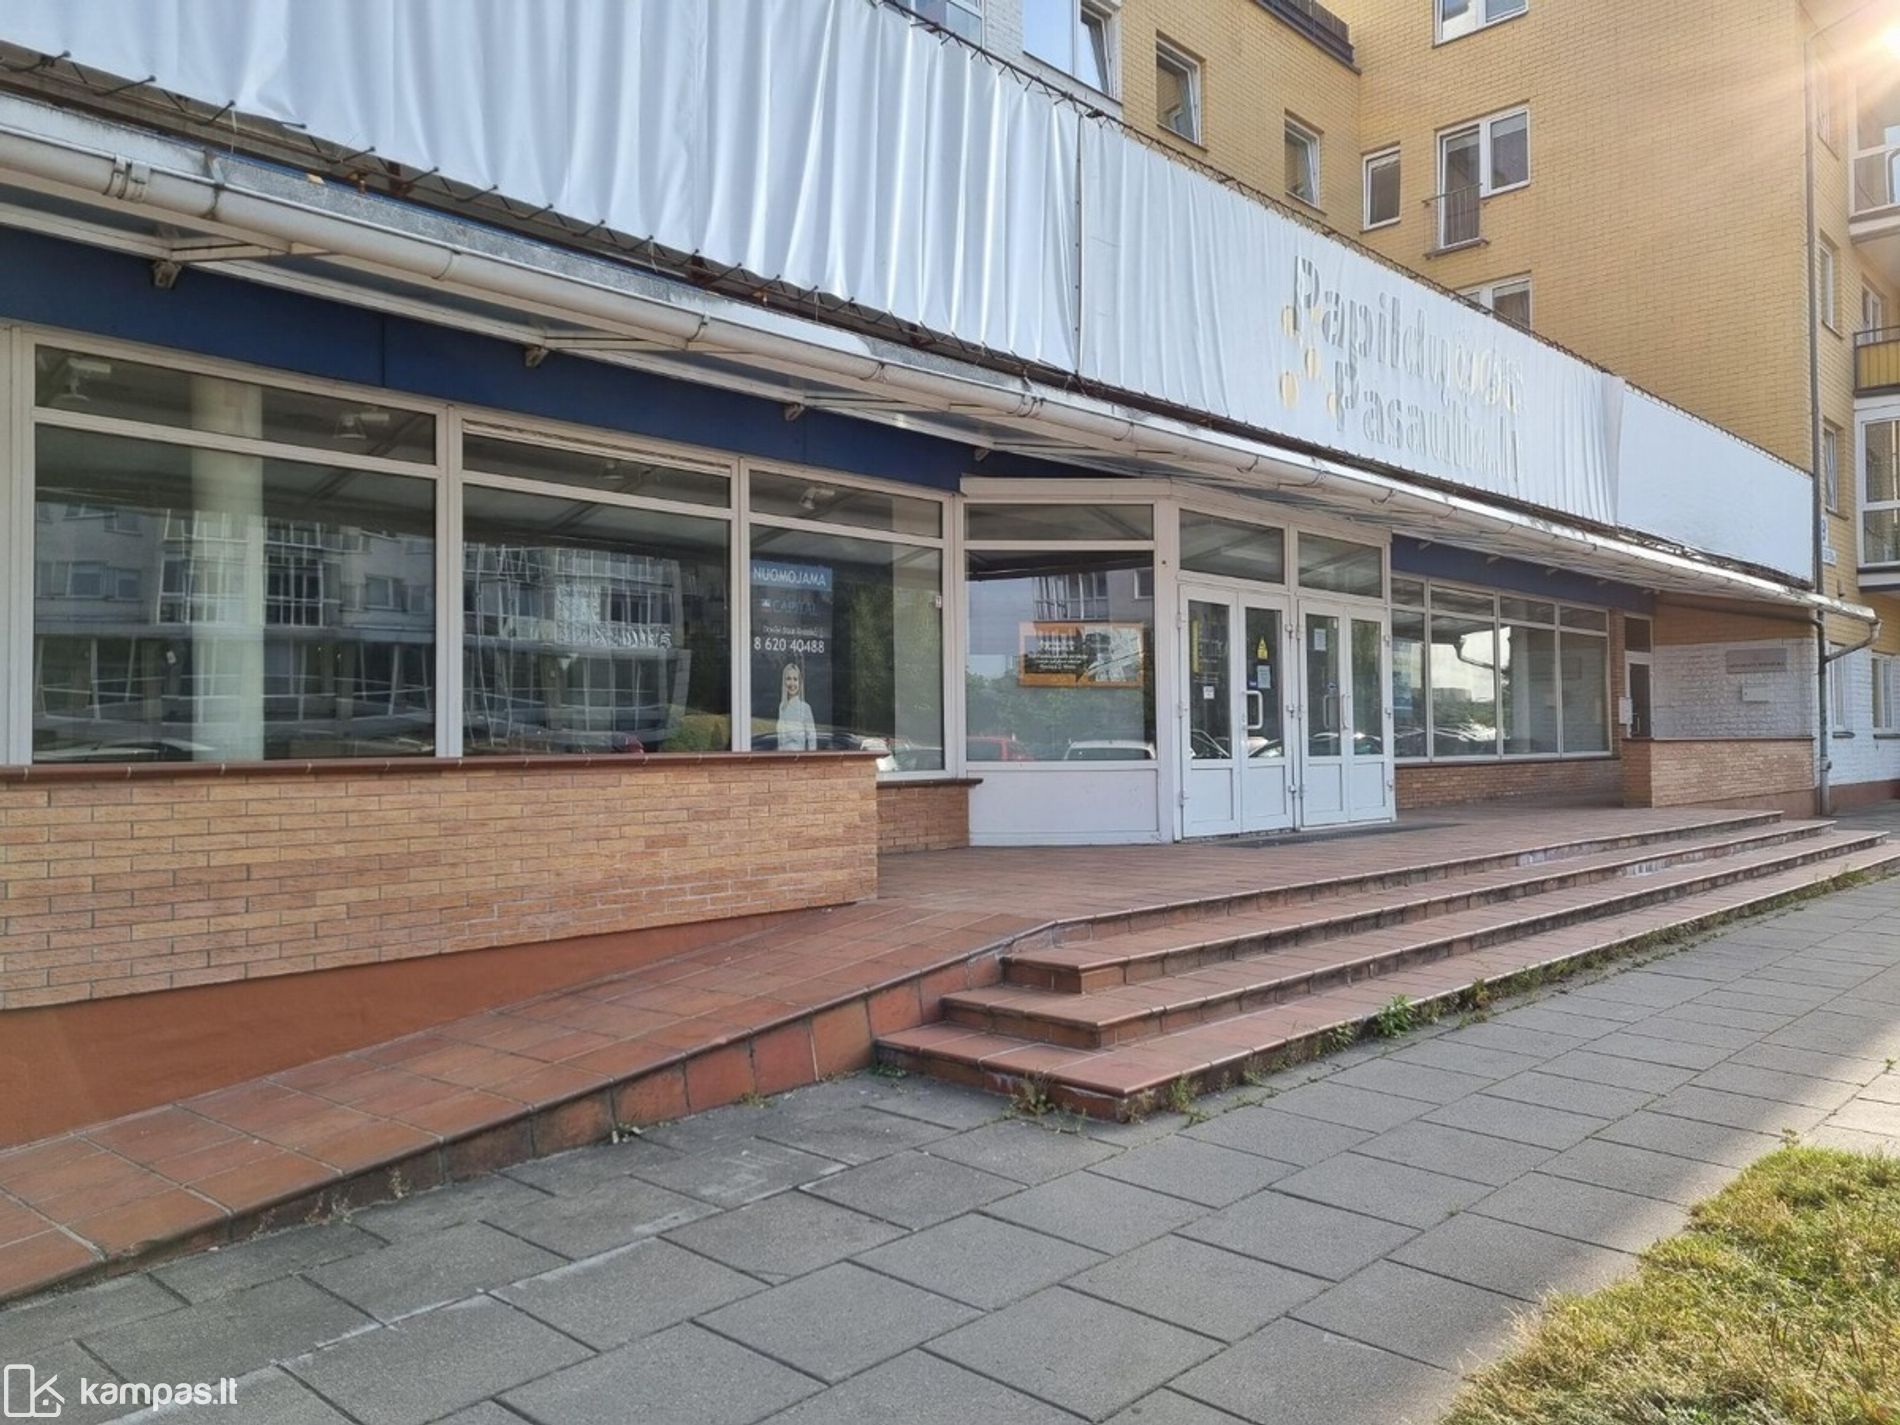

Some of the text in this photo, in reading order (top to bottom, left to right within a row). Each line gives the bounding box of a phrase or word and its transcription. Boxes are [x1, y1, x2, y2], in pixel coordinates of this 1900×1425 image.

[753, 567, 827, 587] NUOMOJAMA
[753, 636, 825, 654] 8 620 40488
